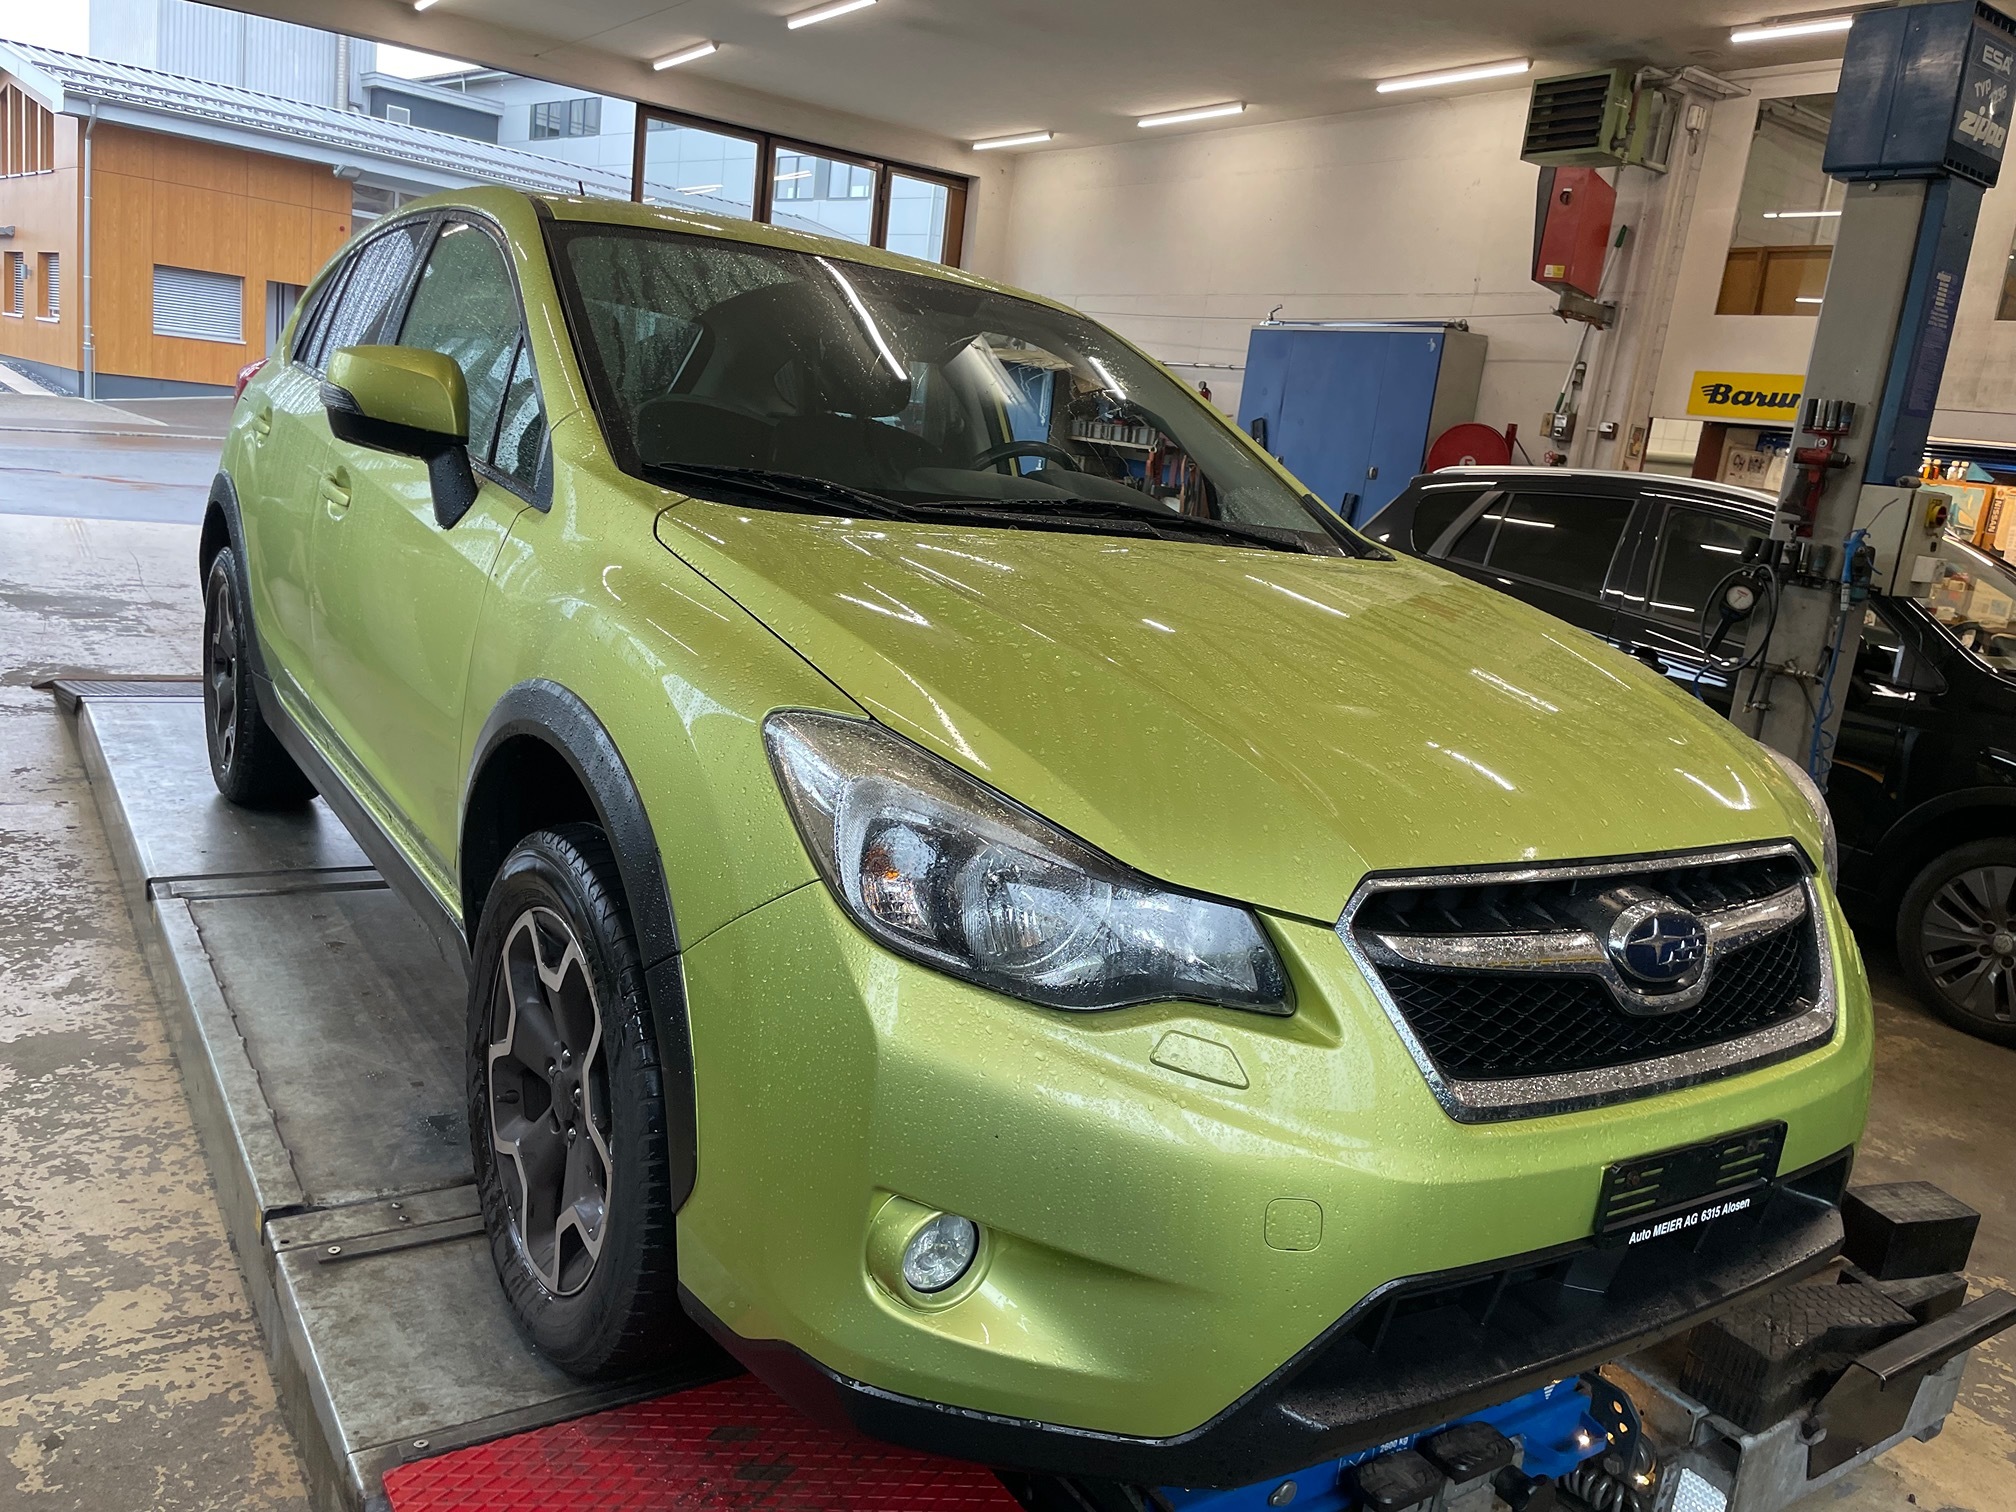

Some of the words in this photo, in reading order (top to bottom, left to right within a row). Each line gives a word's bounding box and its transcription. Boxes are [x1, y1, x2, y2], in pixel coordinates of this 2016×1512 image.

[1982, 44, 2012, 75] ESA
[1974, 78, 1992, 98] TYP
[1988, 500, 2002, 533] NISSAN
[1628, 1229, 1652, 1245] Auto
[1652, 1217, 1683, 1238] MEIER
[1684, 1212, 1698, 1228] AG
[1700, 1204, 1721, 1222] 6315
[1721, 1198, 1751, 1216] Alosen
